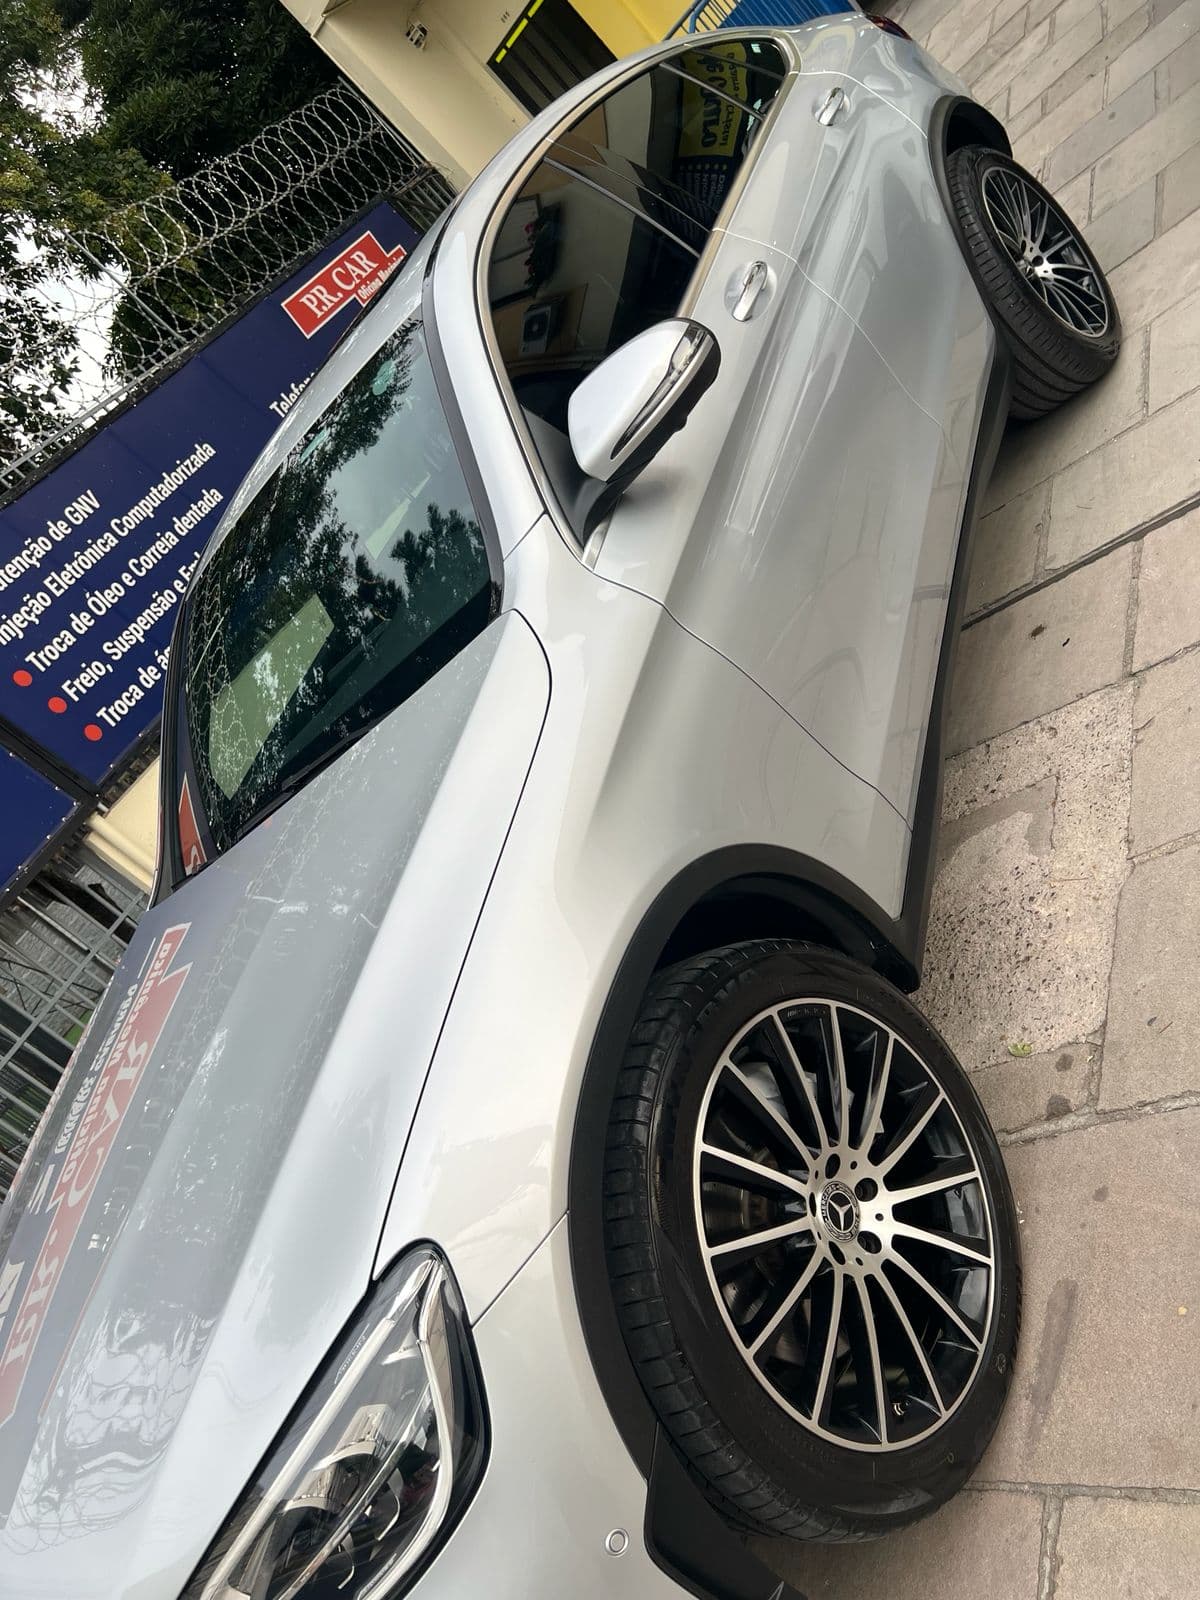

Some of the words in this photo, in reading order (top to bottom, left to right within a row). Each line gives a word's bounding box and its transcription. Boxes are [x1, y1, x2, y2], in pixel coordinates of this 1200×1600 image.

[331, 250, 379, 291] CAR
[43, 536, 118, 598] Eletrônica
[110, 441, 217, 537] Computadorizada
[47, 519, 72, 542] de
[63, 489, 101, 527] GNV
[172, 486, 224, 537] dentada
[127, 531, 181, 577] Correia
[121, 571, 137, 588] e
[70, 610, 95, 634] de
[86, 588, 126, 618] Óleo
[25, 628, 77, 673] Troca
[61, 661, 113, 702] Freio,
[102, 589, 178, 661] Suspensão
[173, 579, 188, 594] e
[95, 685, 144, 730] Troca
[137, 666, 162, 689] de
